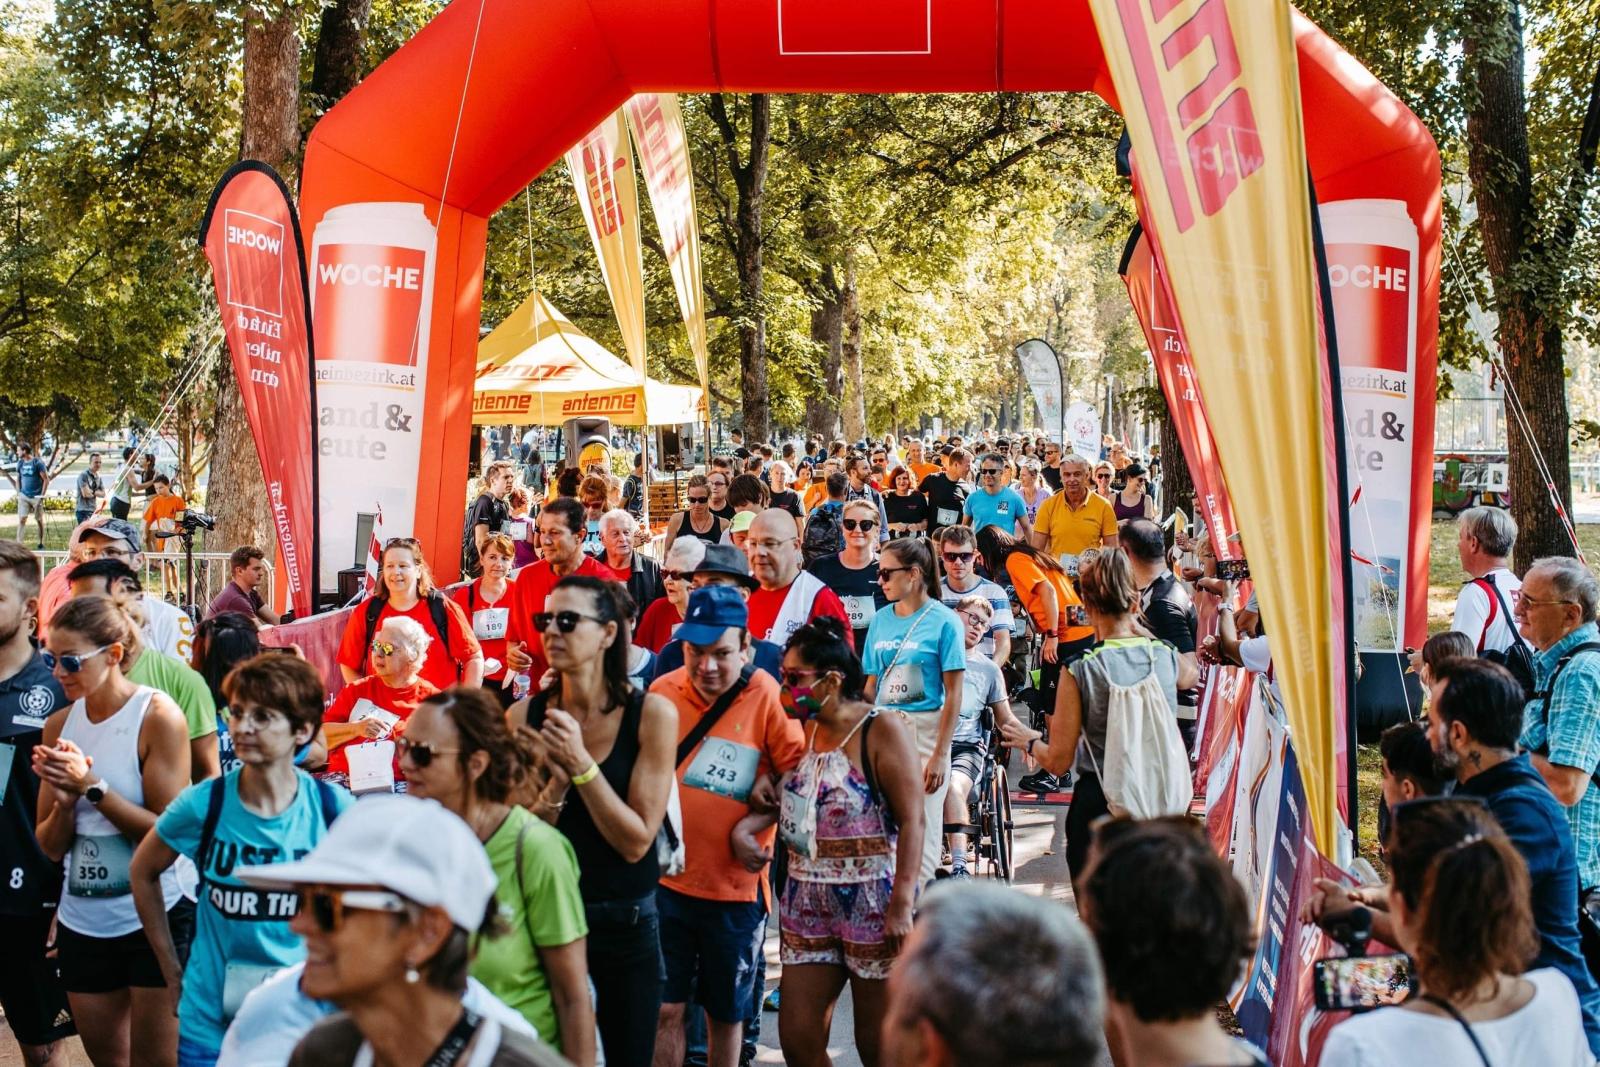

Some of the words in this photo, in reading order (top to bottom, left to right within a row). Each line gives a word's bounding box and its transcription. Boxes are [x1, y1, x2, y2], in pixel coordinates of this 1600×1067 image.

[319, 263, 420, 290] WOCHE
[562, 393, 636, 411] antenne
[486, 622, 502, 631] 189
[889, 684, 908, 693] 290
[706, 763, 737, 782] 243
[9, 867, 24, 889] 8
[79, 866, 108, 880] 350
[208, 884, 259, 915] OUR
